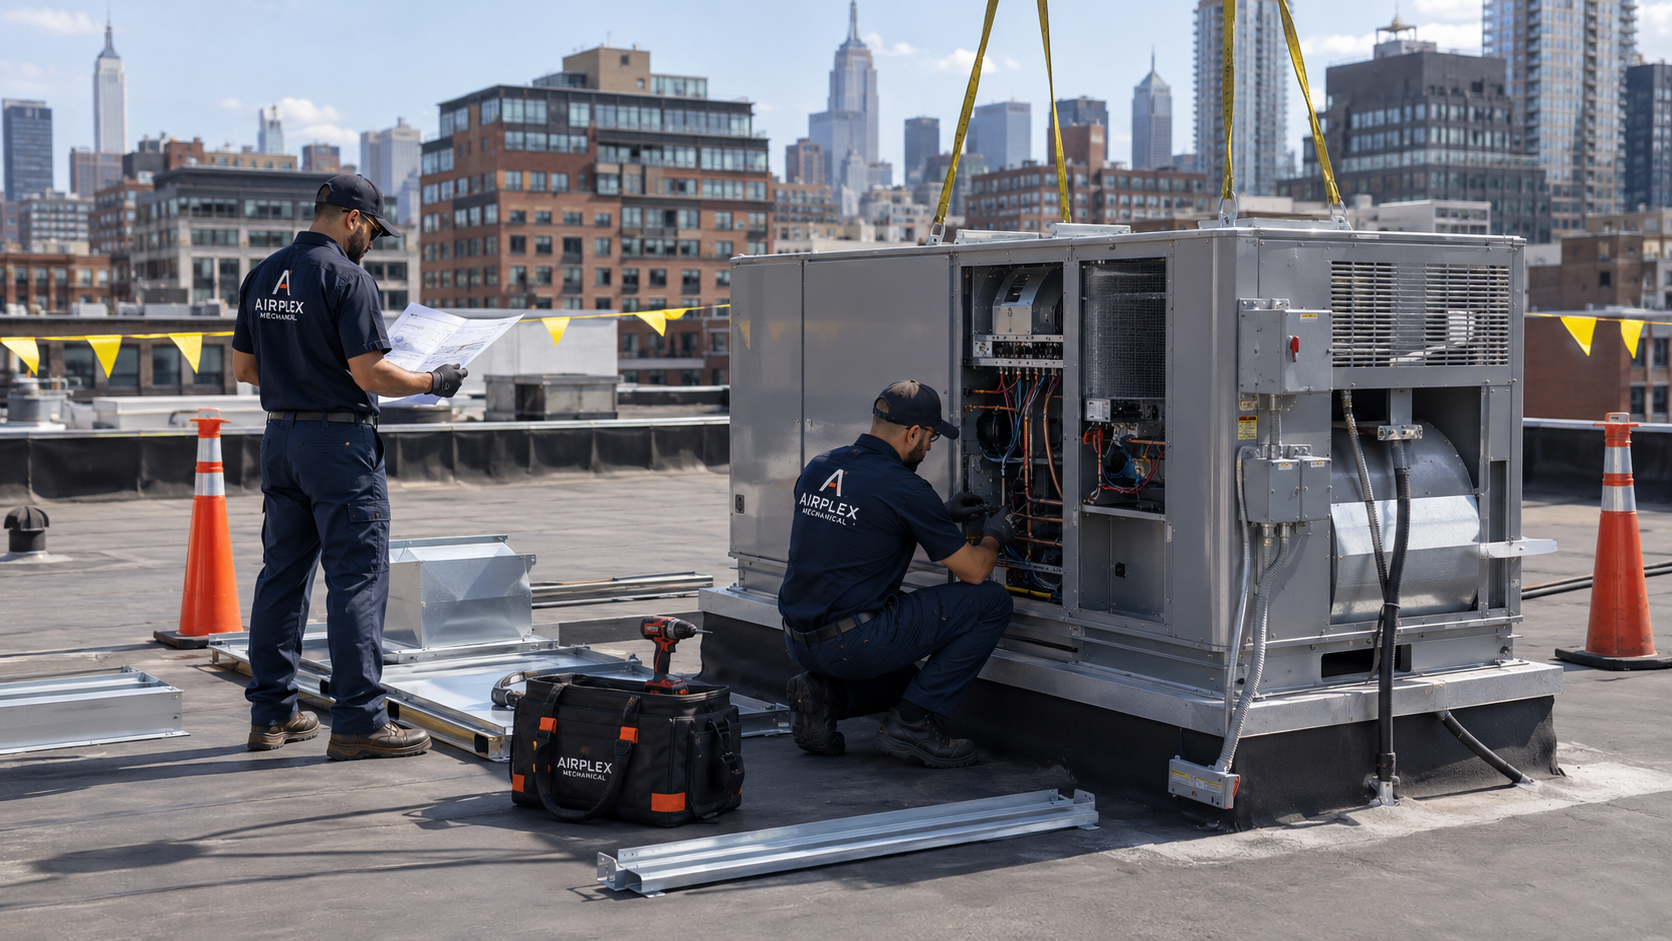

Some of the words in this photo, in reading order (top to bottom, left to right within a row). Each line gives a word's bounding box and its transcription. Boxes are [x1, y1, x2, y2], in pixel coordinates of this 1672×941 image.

[255, 298, 304, 314] AIRPLEX
[799, 492, 859, 520] AIRPLEX
[802, 508, 846, 526] MECHANICAL
[557, 757, 612, 774] AIRPLEX
[563, 770, 606, 781] MECHANICAL
